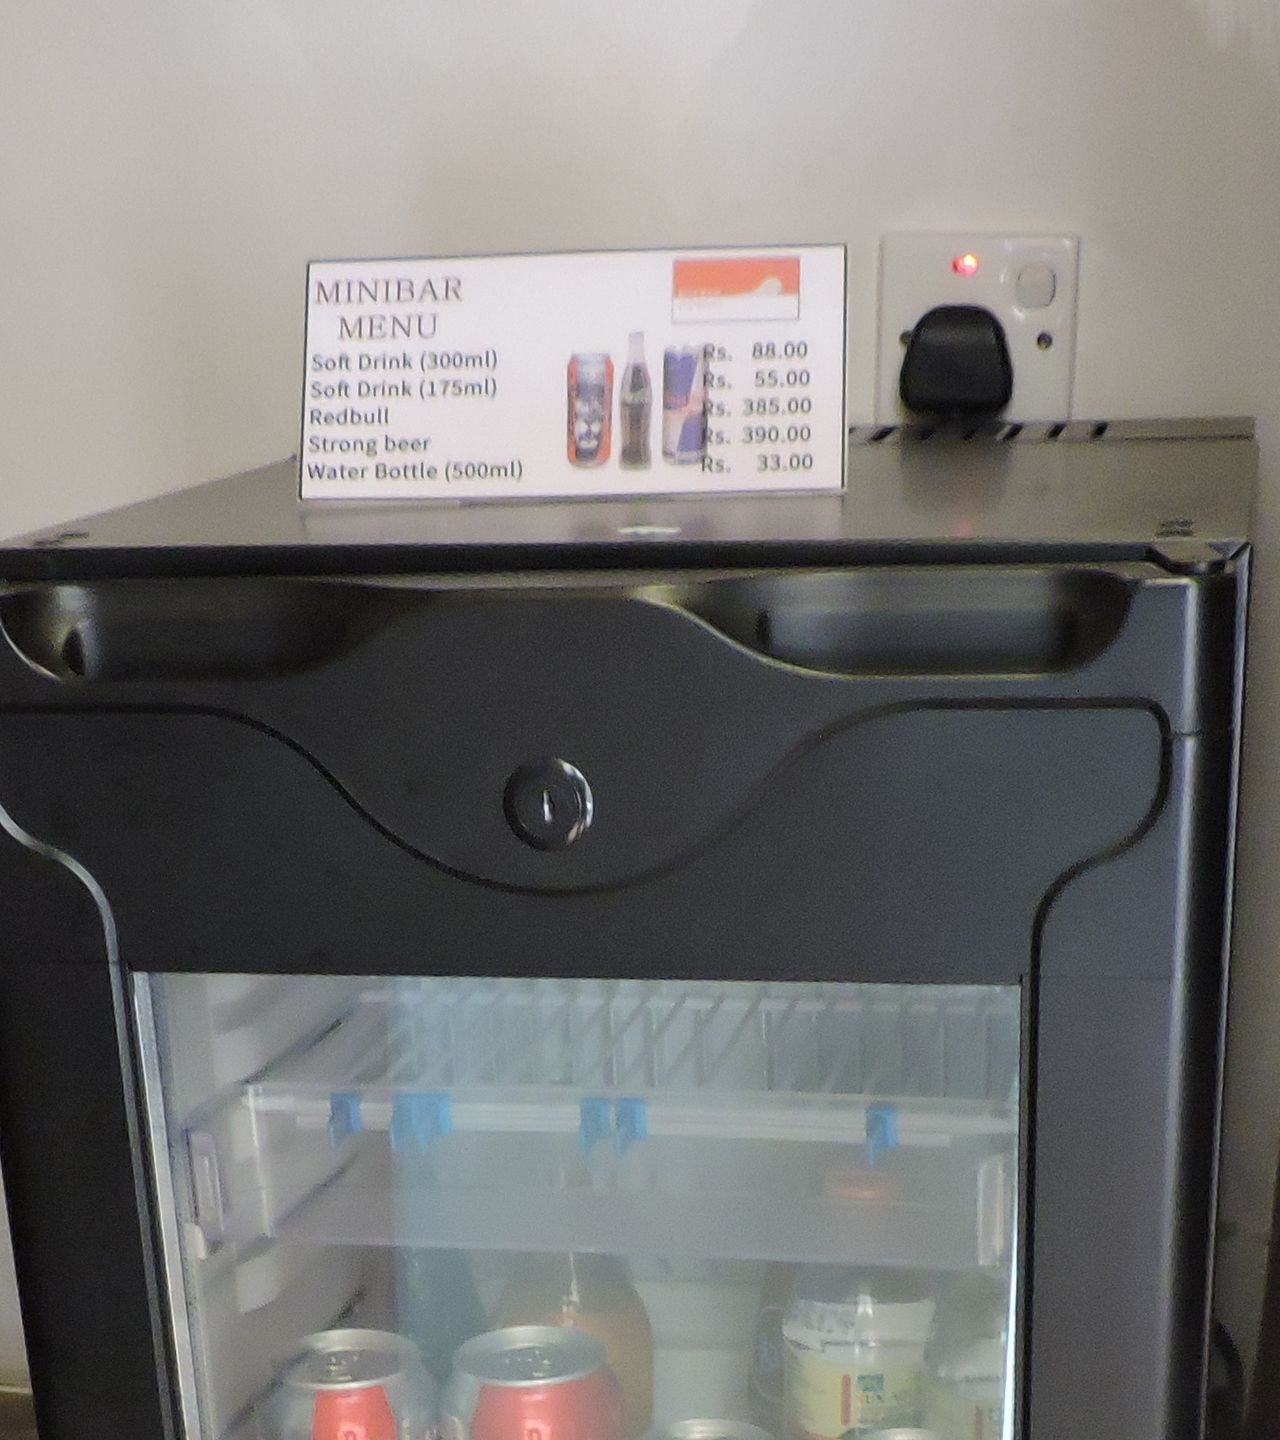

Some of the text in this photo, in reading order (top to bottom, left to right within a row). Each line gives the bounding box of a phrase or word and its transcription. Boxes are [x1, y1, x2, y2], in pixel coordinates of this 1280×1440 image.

[315, 276, 464, 305] MINIBAR
[337, 313, 439, 340] MENU
[311, 349, 498, 373] Soft Drink (300ml)
[703, 341, 808, 361] Rs. 88.00
[311, 377, 498, 399] Soft Drink (175ml)
[703, 370, 810, 389] Rs. 55.00
[310, 408, 389, 425] Redbull
[703, 398, 812, 417] Rs. 385.00
[742, 426, 811, 444] 390.00
[308, 435, 431, 456] Strong beer
[307, 460, 523, 482] Water Bottle (500ml)
[702, 454, 813, 473] Rs. 33.00
